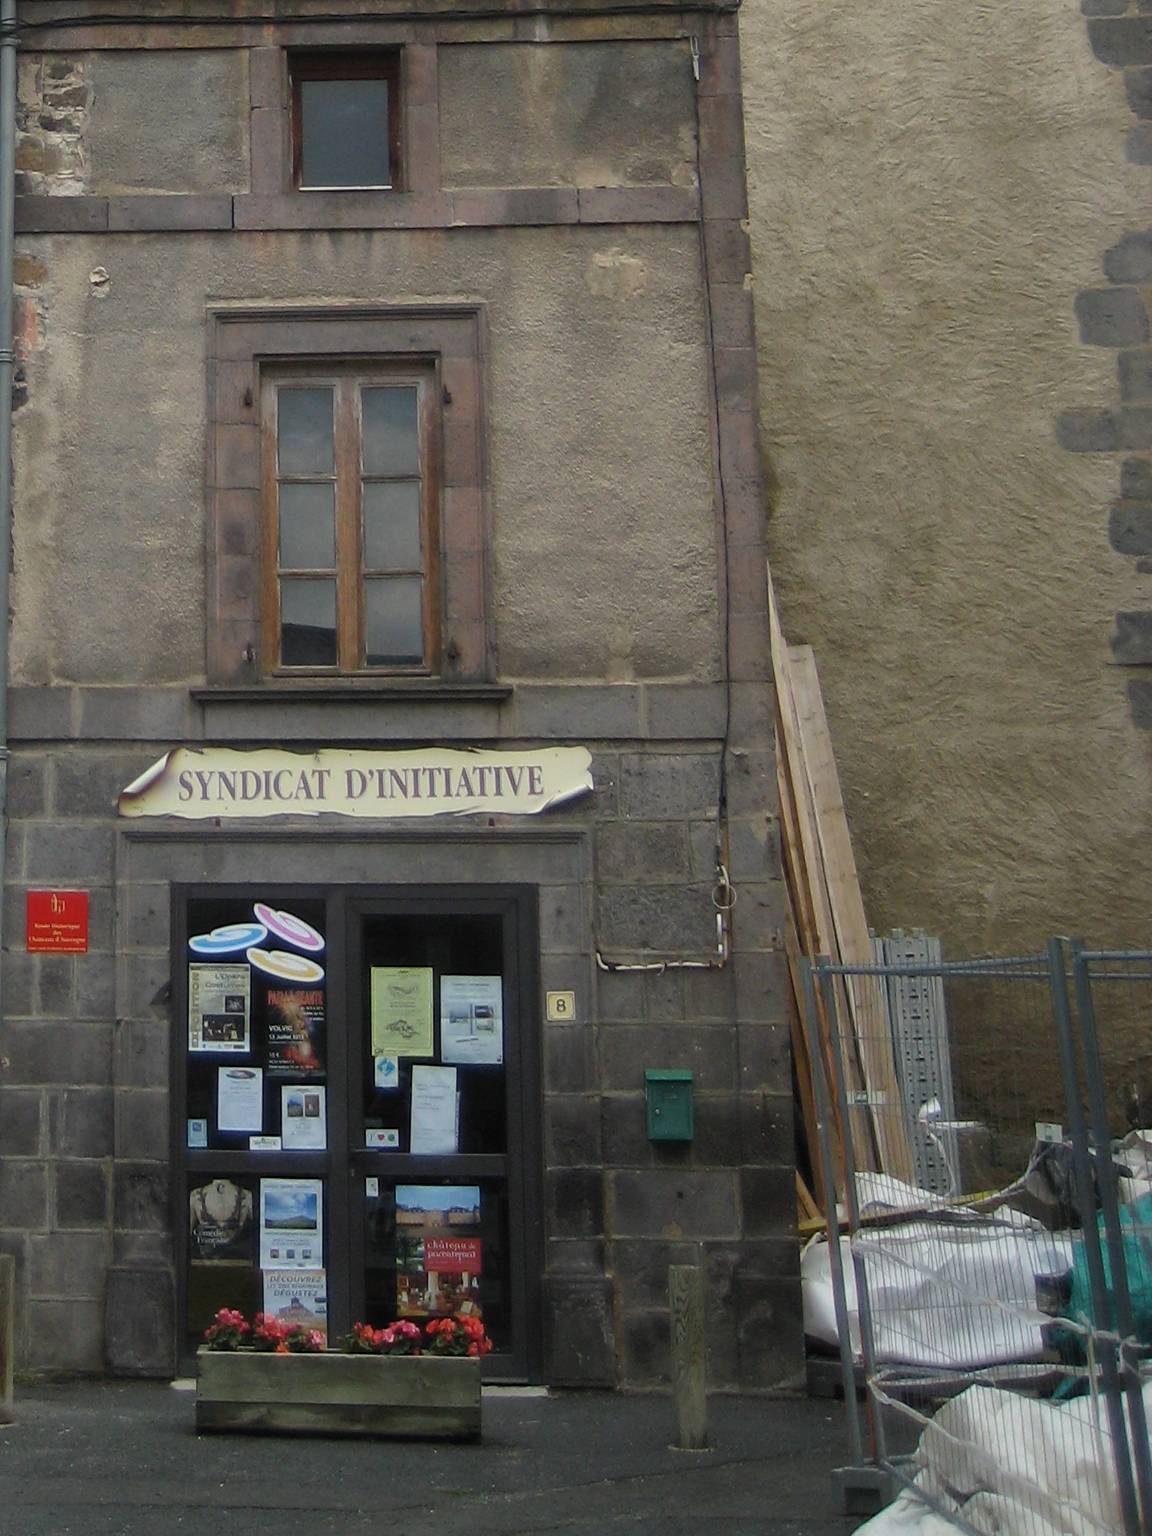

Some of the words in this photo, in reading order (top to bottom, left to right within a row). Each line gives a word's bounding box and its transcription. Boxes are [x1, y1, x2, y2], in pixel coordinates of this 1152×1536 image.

[178, 768, 331, 802] SYNDICAT
[345, 765, 545, 800] D'INITIATIVE
[556, 999, 566, 1012] 8
